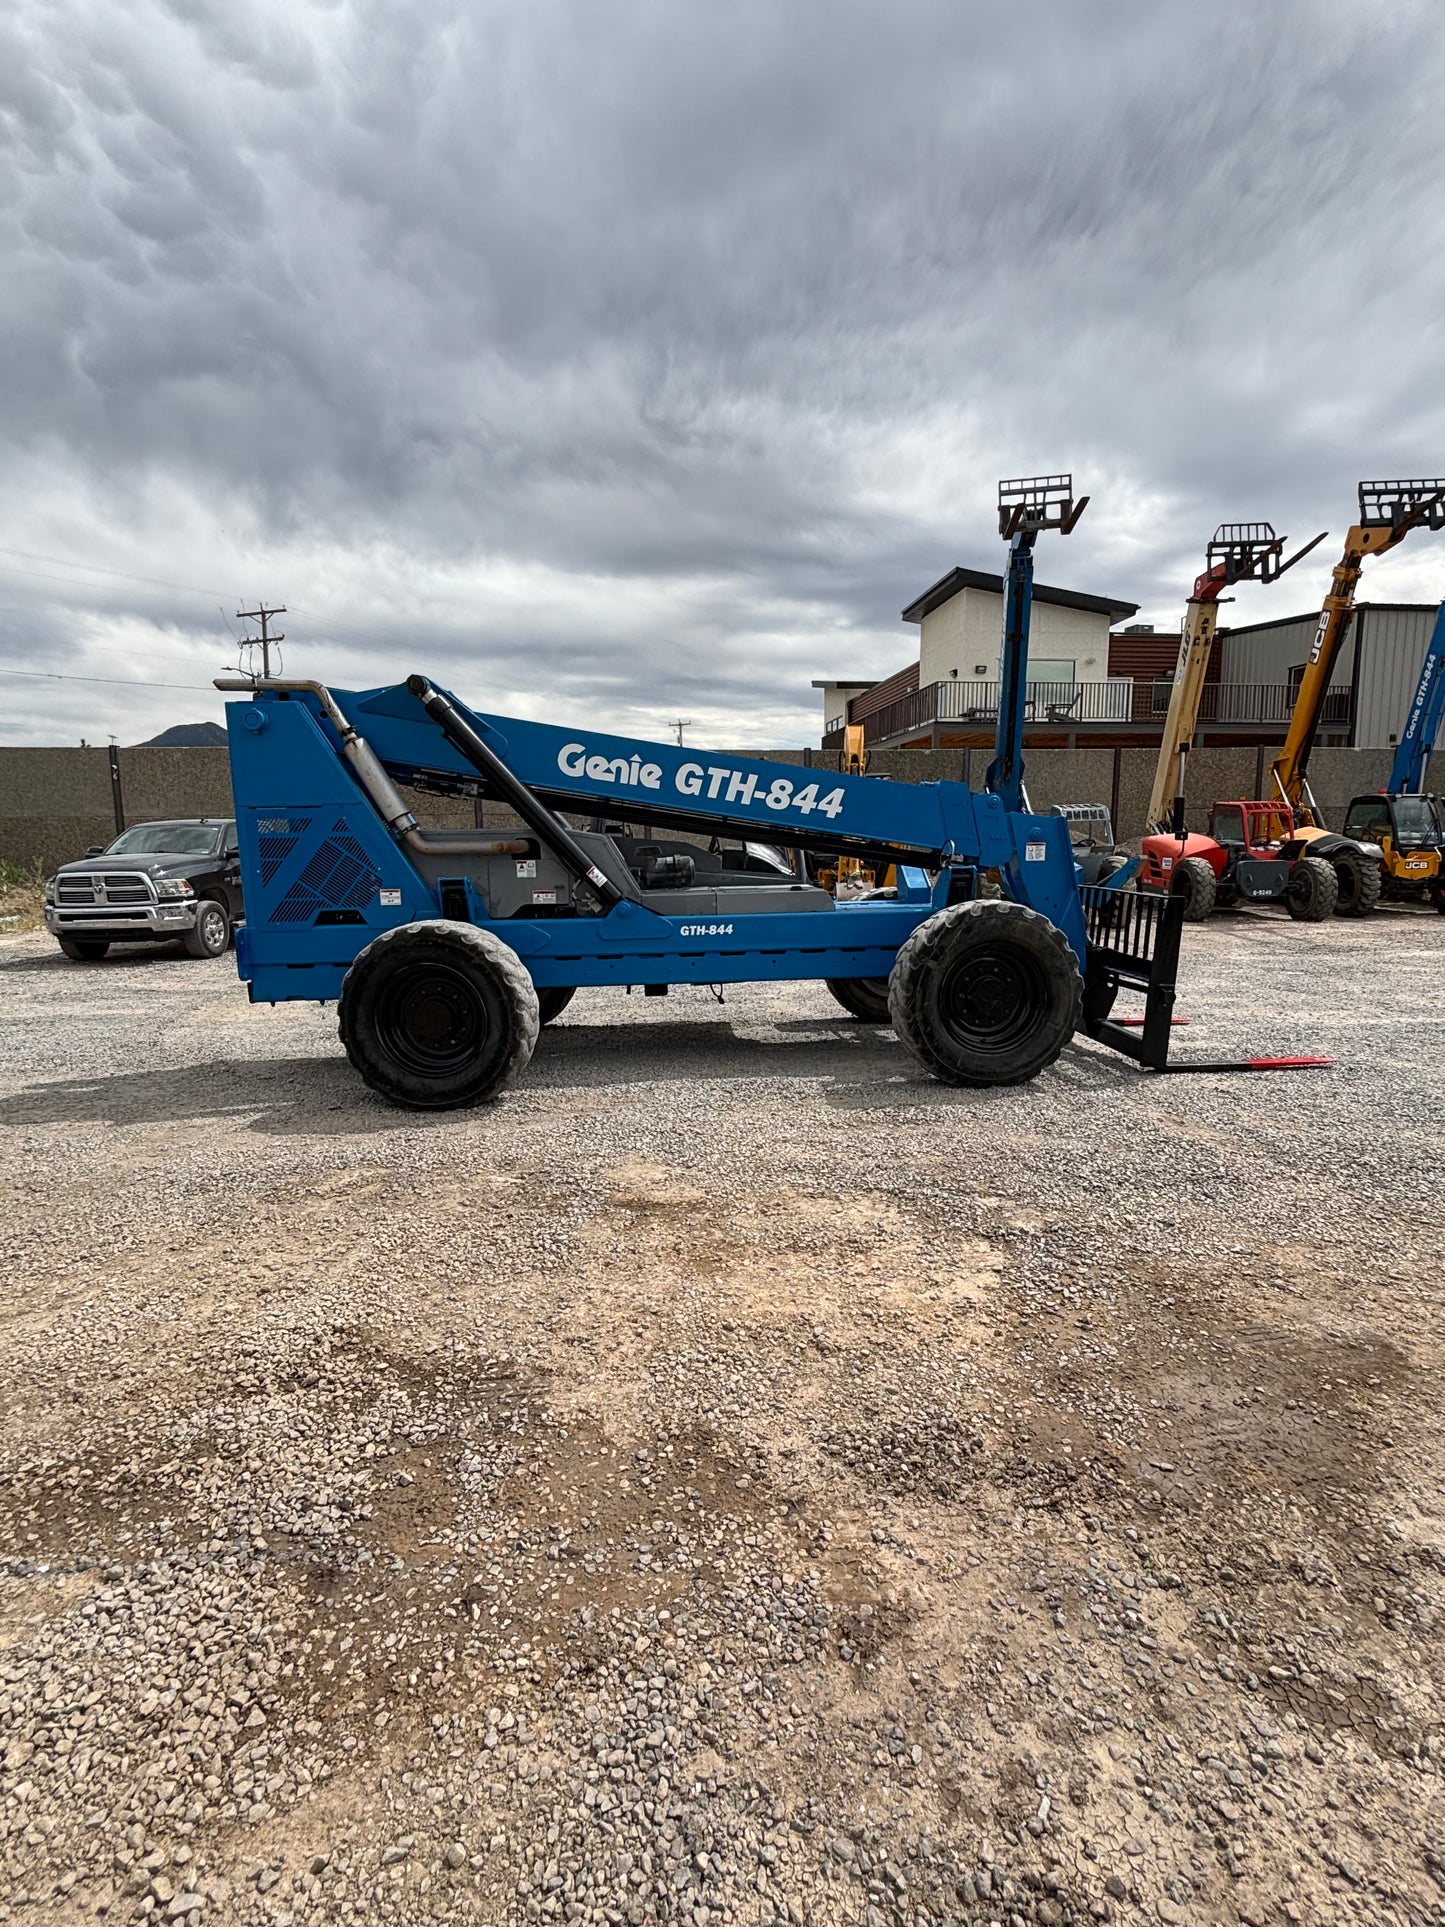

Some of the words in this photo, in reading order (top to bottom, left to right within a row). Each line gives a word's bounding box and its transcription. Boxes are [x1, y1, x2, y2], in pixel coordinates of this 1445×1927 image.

[1181, 630, 1191, 667] JLG
[1309, 611, 1330, 664] JCB
[1406, 709, 1421, 739] Genie
[1416, 654, 1436, 706] GTH-844
[557, 743, 663, 790] Genie
[675, 763, 846, 819] GTH-844
[1405, 861, 1428, 869] JCB
[680, 924, 734, 936] GTH-844
